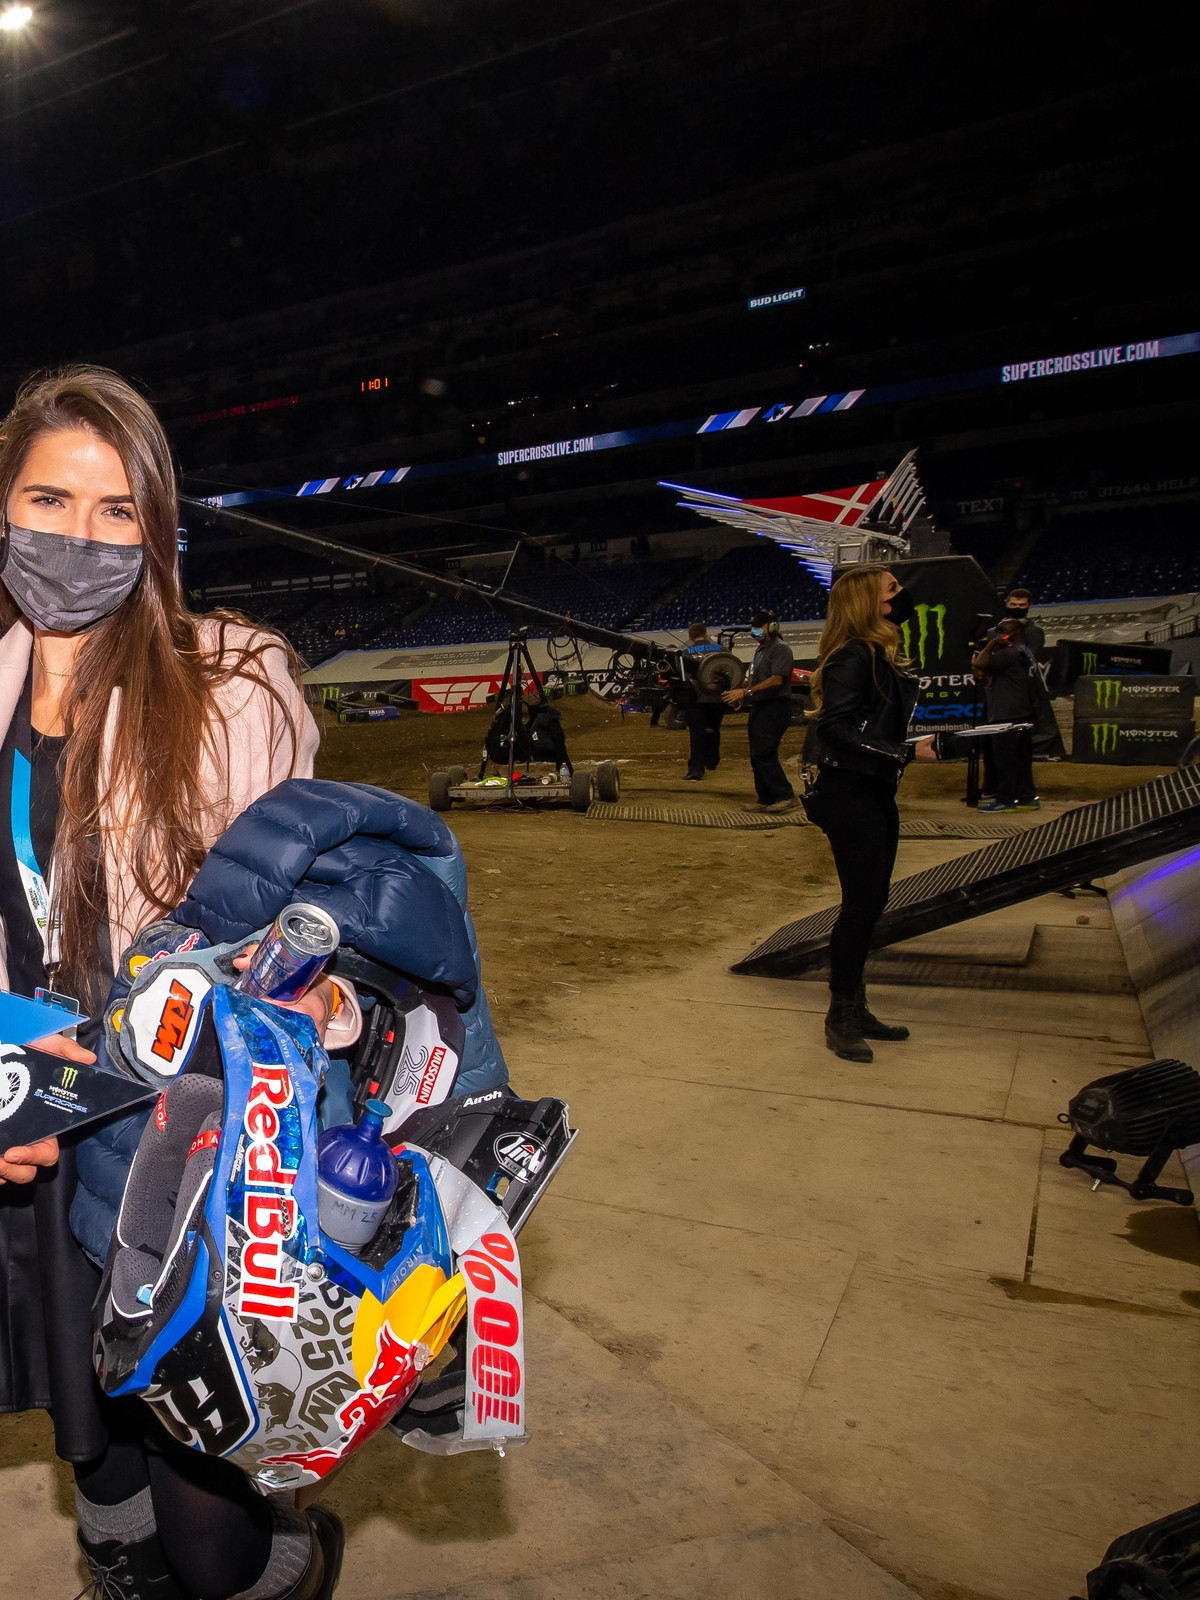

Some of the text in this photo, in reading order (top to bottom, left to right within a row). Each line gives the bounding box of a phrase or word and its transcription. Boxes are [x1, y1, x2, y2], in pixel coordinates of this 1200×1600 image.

[750, 288, 804, 308] BUD LIGHT
[1002, 340, 1160, 383] SUPERCROSSLIVE.COM
[359, 376, 390, 393] 11:01
[497, 437, 595, 466] SUPERCROSSLIVE.COM
[1121, 685, 1181, 694] MONSTER
[1119, 729, 1179, 739] MONSTER
[150, 978, 194, 1063] KTM
[280, 1038, 307, 1105] GIVES YOU WINGS
[392, 1044, 430, 1097] 25
[419, 1048, 445, 1103] MUSQUIN
[33, 1090, 88, 1114] SUPERCROSS
[462, 1089, 503, 1108] Airoh
[239, 1063, 300, 1322] Red Bull
[360, 1211, 377, 1225] 25
[391, 1243, 425, 1287] AIROH
[291, 1306, 346, 1371] 25
[471, 1231, 522, 1427] 100%
